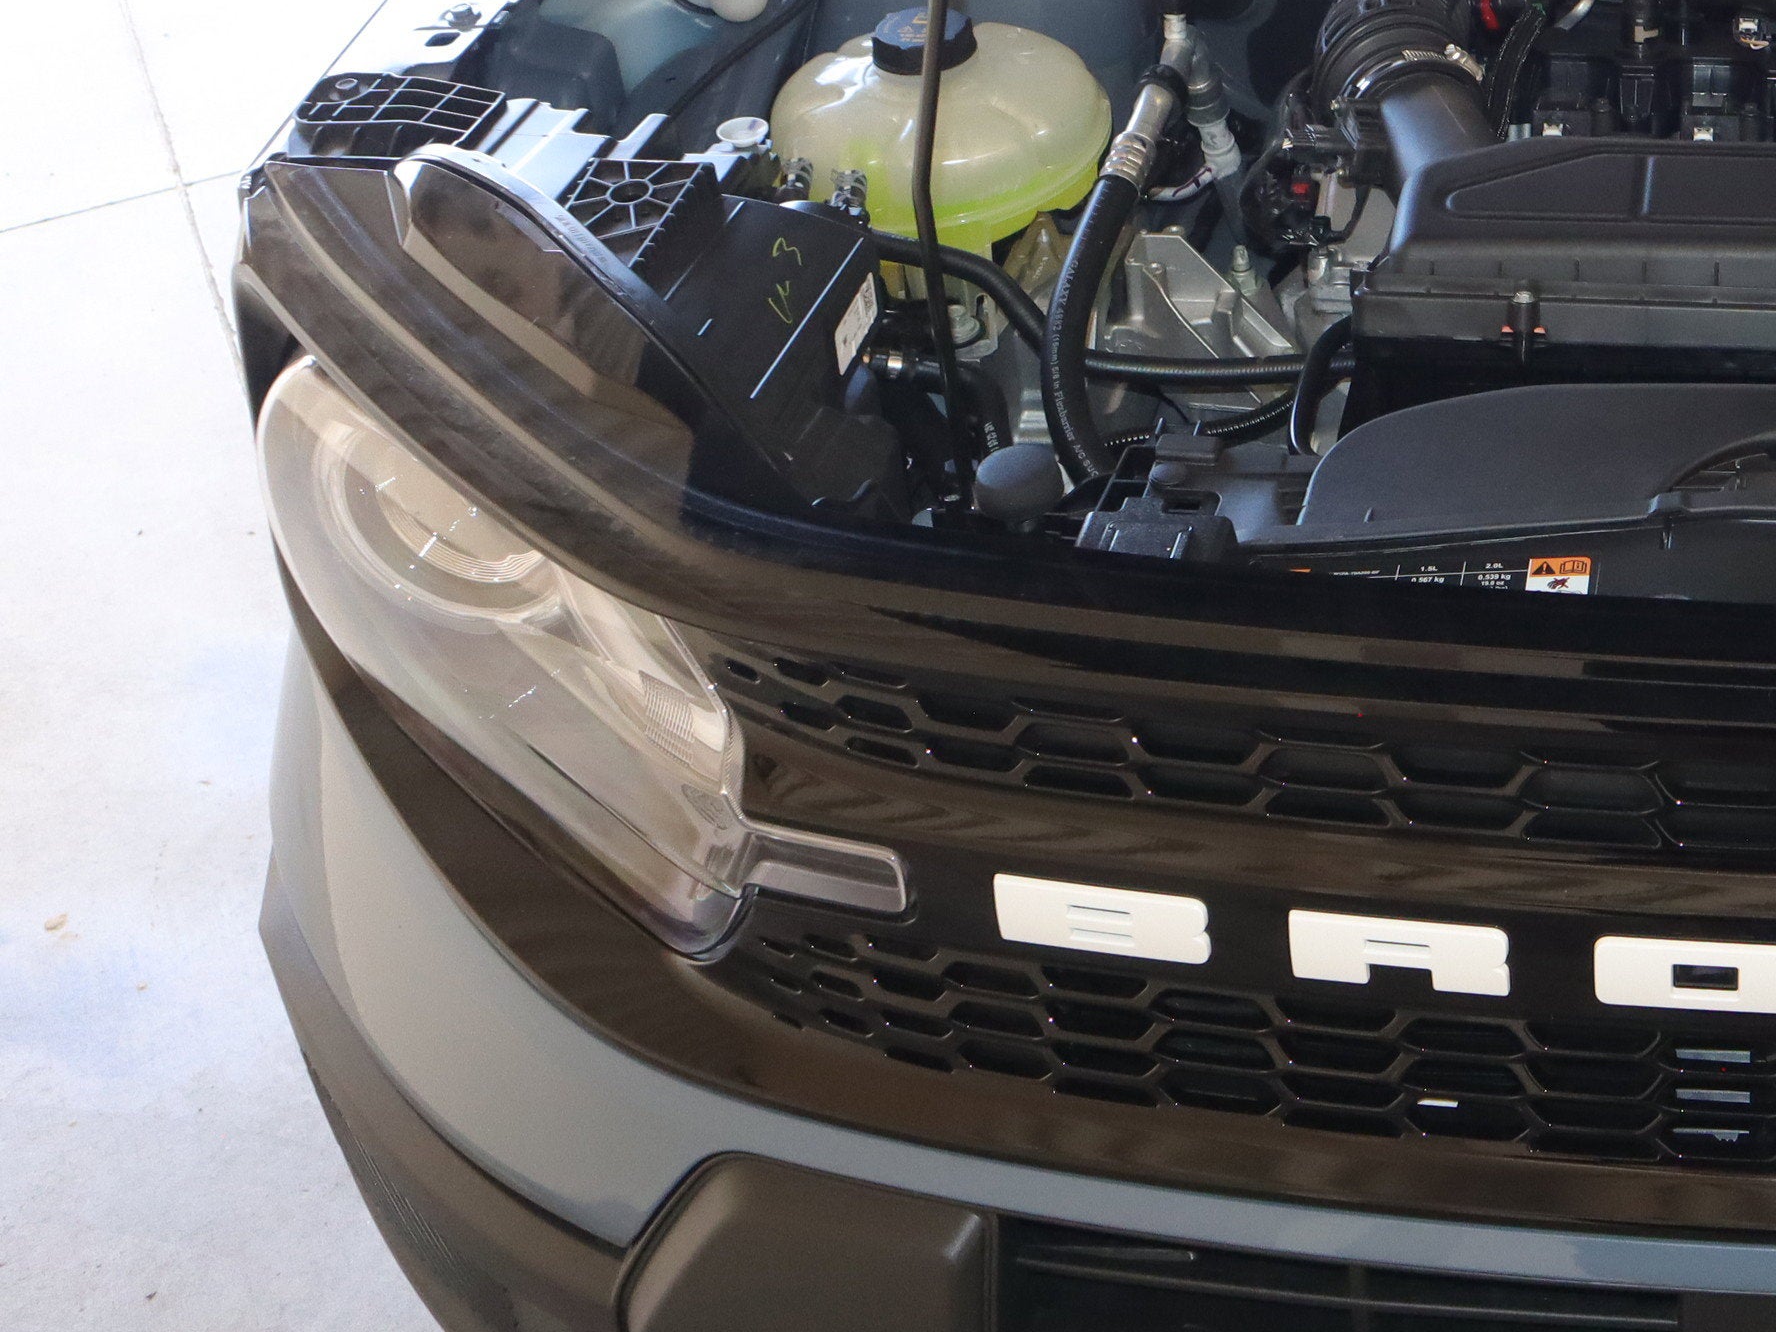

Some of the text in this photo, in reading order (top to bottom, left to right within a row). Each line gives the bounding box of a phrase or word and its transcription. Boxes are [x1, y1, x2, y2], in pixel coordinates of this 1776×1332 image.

[1060, 260, 1080, 306] GALAXY
[1054, 390, 1076, 442] Flexbarrier
[1073, 442, 1086, 461] A/C
